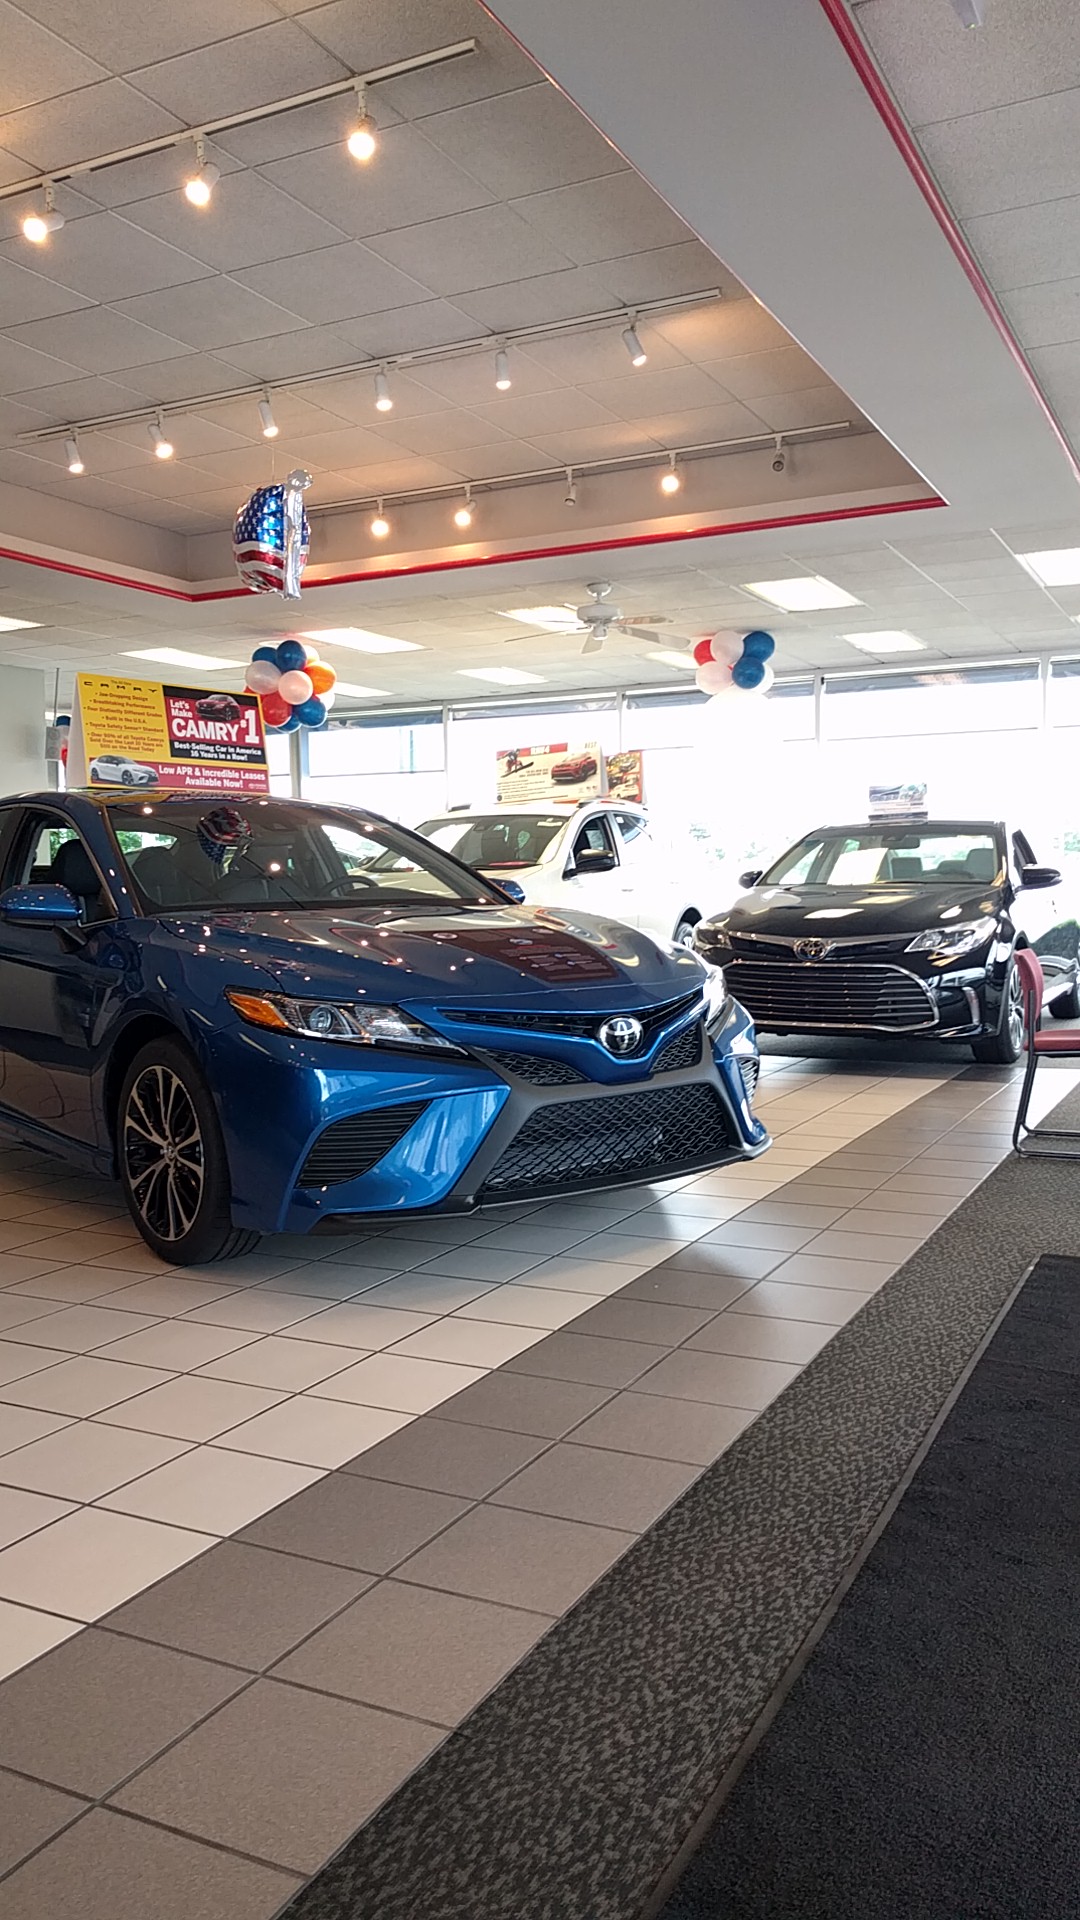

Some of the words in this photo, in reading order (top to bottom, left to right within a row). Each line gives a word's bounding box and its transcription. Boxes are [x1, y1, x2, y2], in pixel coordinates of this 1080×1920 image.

[170, 699, 189, 709] Let's
[172, 708, 193, 718] Make
[172, 718, 239, 742] CAMRY
[174, 742, 214, 752] Best-Selling
[236, 747, 262, 755] America
[159, 765, 174, 774] Low
[177, 766, 193, 775] APR
[202, 768, 239, 778] Incredible
[241, 771, 265, 780] Leases
[186, 776, 221, 786] Available
[223, 779, 243, 788] Now!
